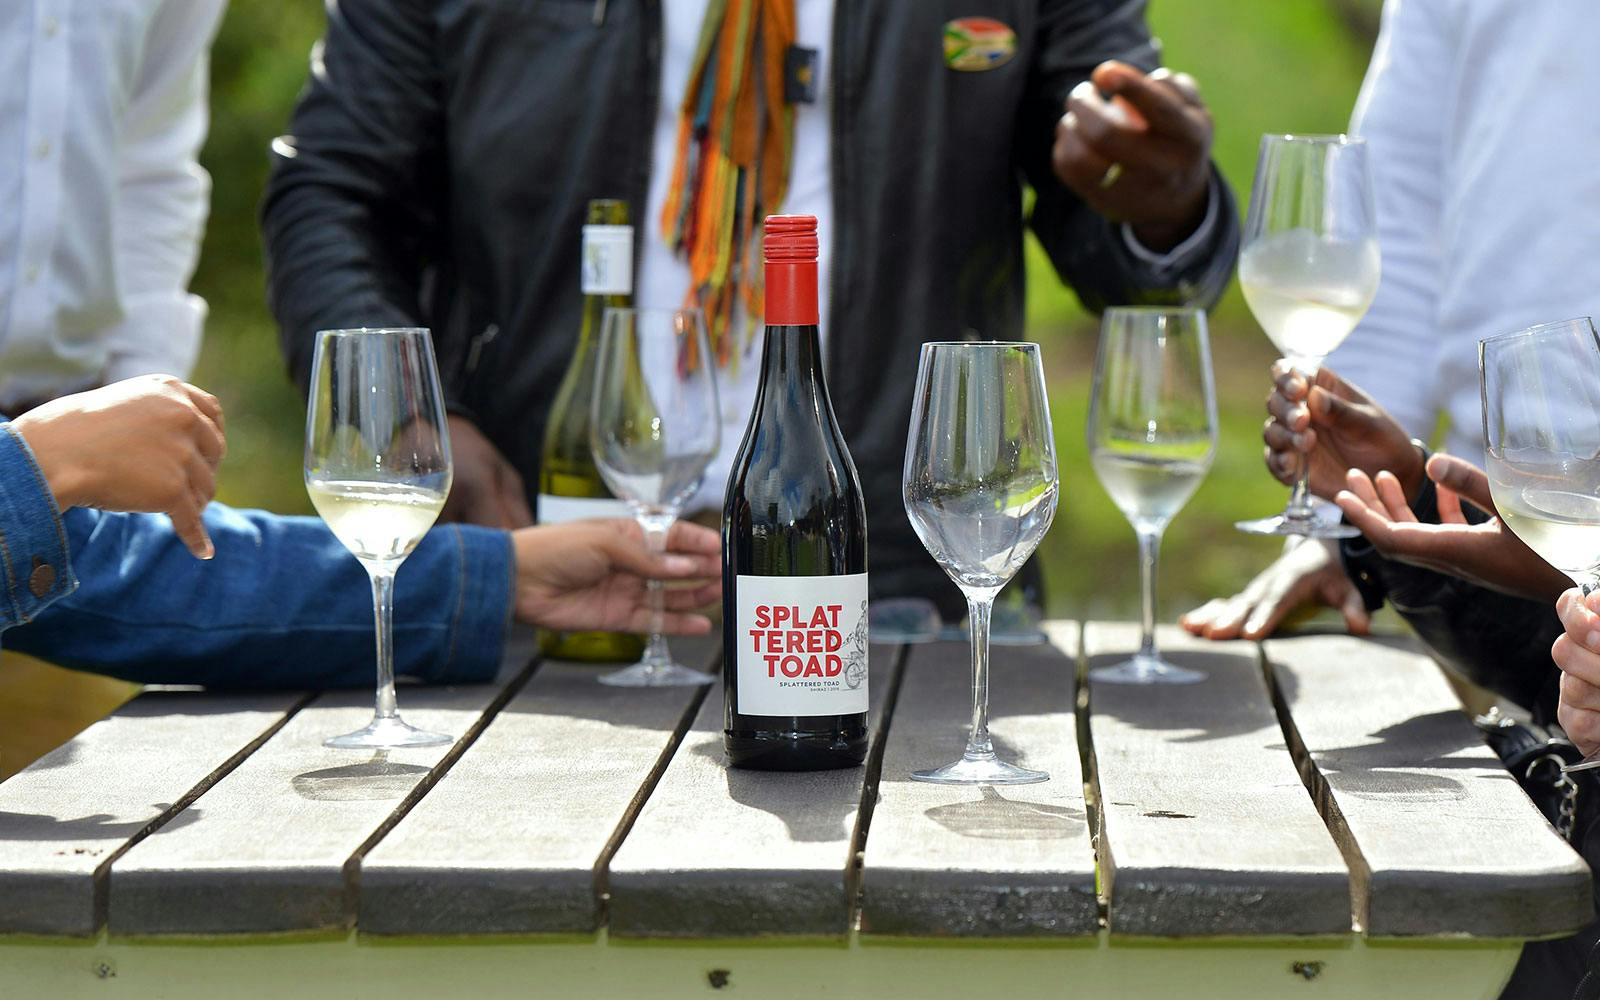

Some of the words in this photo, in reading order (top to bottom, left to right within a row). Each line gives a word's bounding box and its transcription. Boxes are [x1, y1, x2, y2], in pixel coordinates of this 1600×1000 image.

[755, 605, 843, 629] SPLAT
[749, 630, 843, 653] TERED
[763, 655, 843, 678] TOAD
